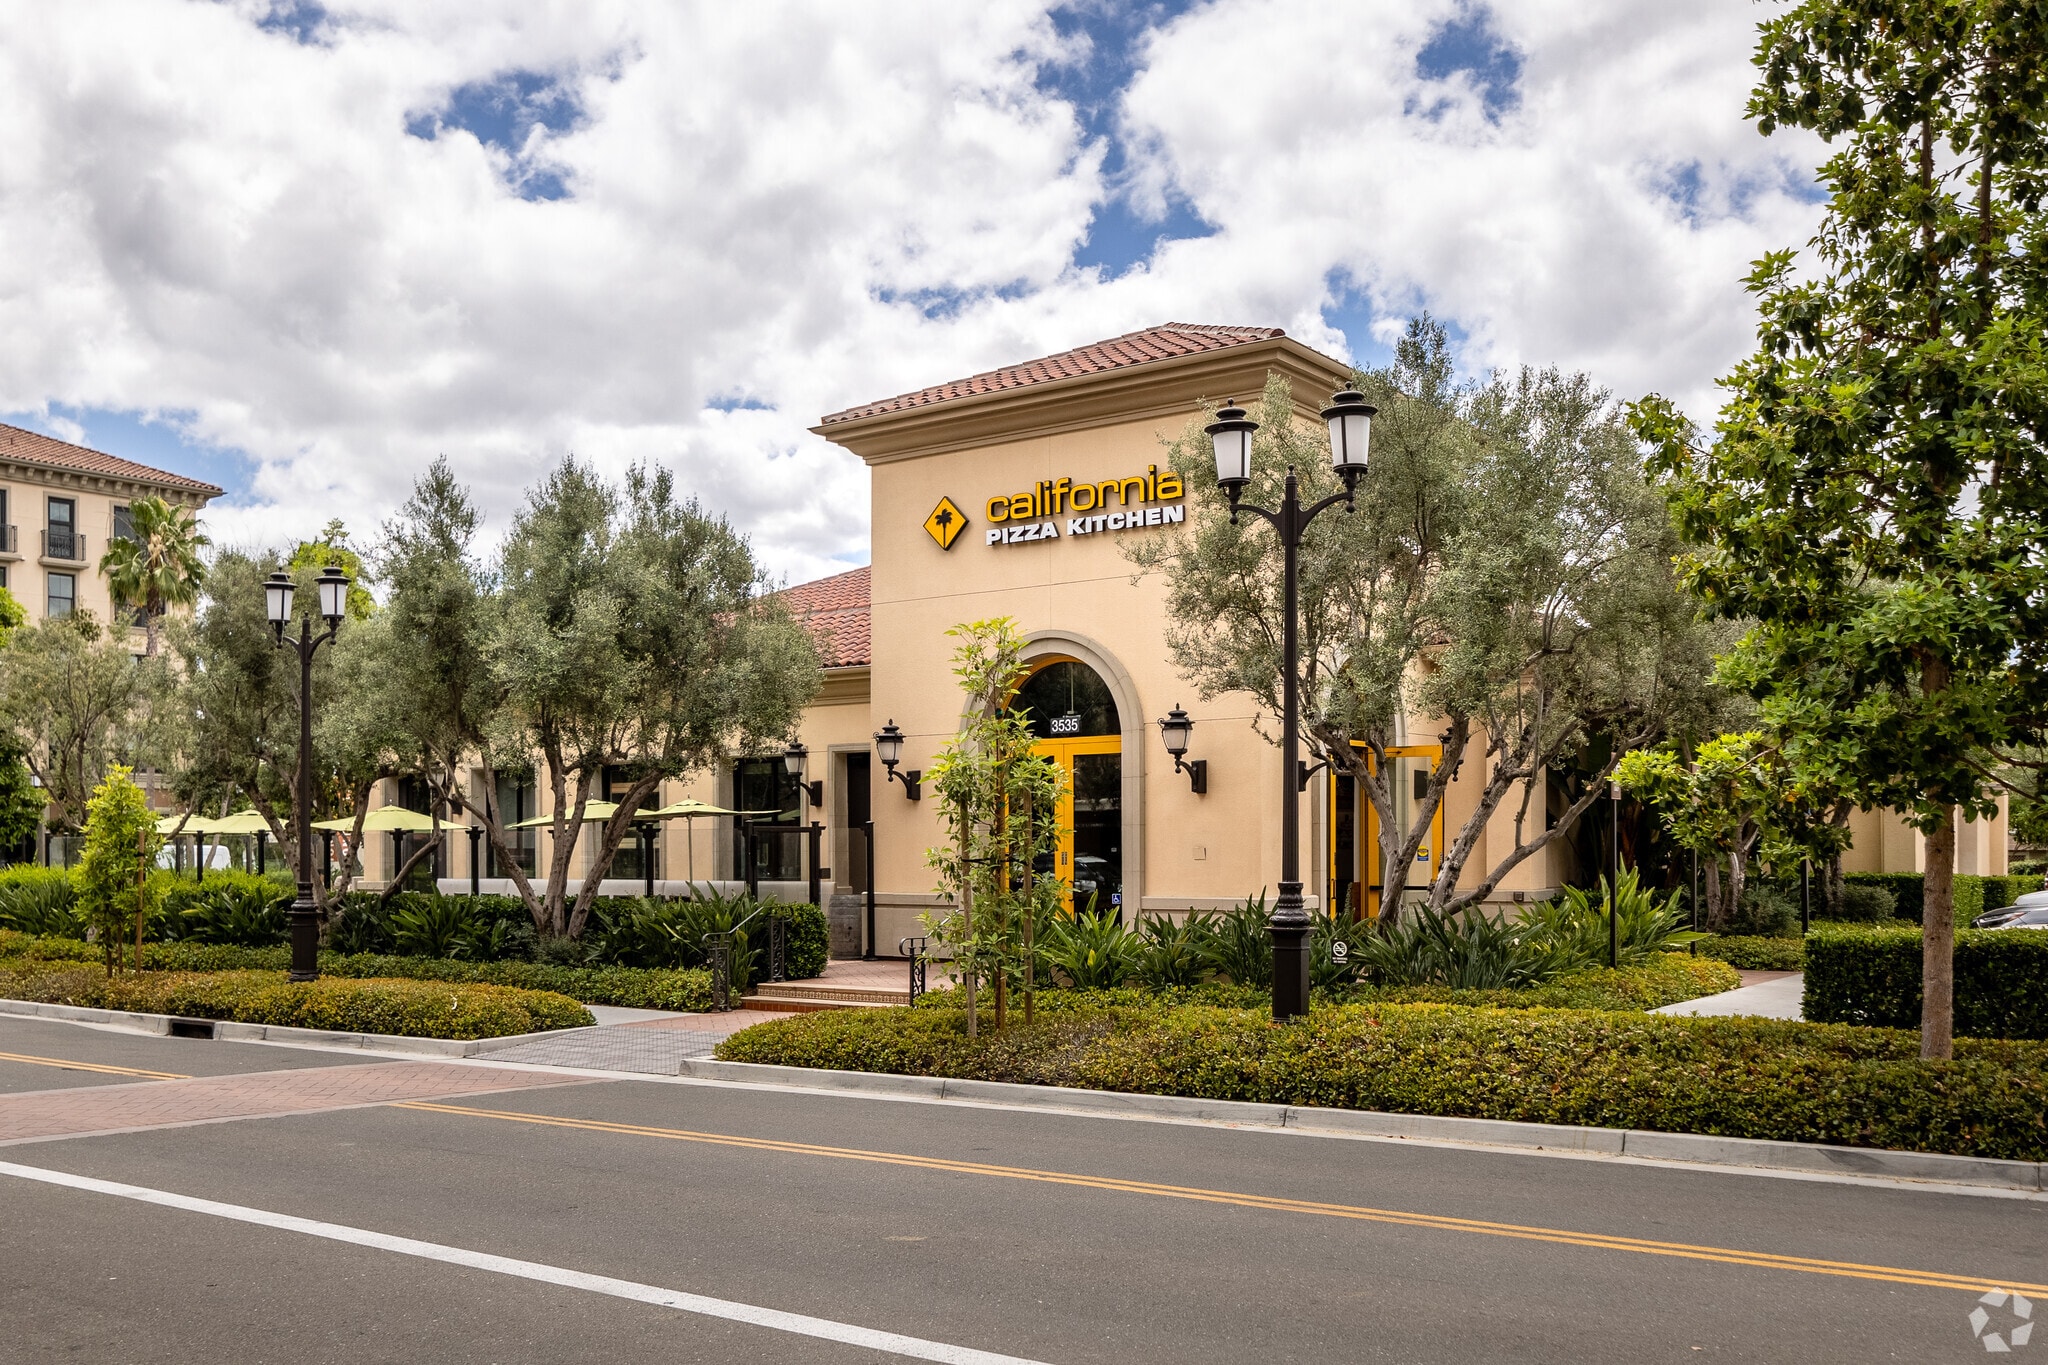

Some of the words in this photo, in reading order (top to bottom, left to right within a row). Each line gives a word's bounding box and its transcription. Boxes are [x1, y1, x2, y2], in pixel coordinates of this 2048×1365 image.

[986, 464, 1184, 523] california
[985, 522, 1059, 546] PIZZA
[1066, 504, 1185, 536] KITCHEN
[1051, 718, 1078, 732] 3535
